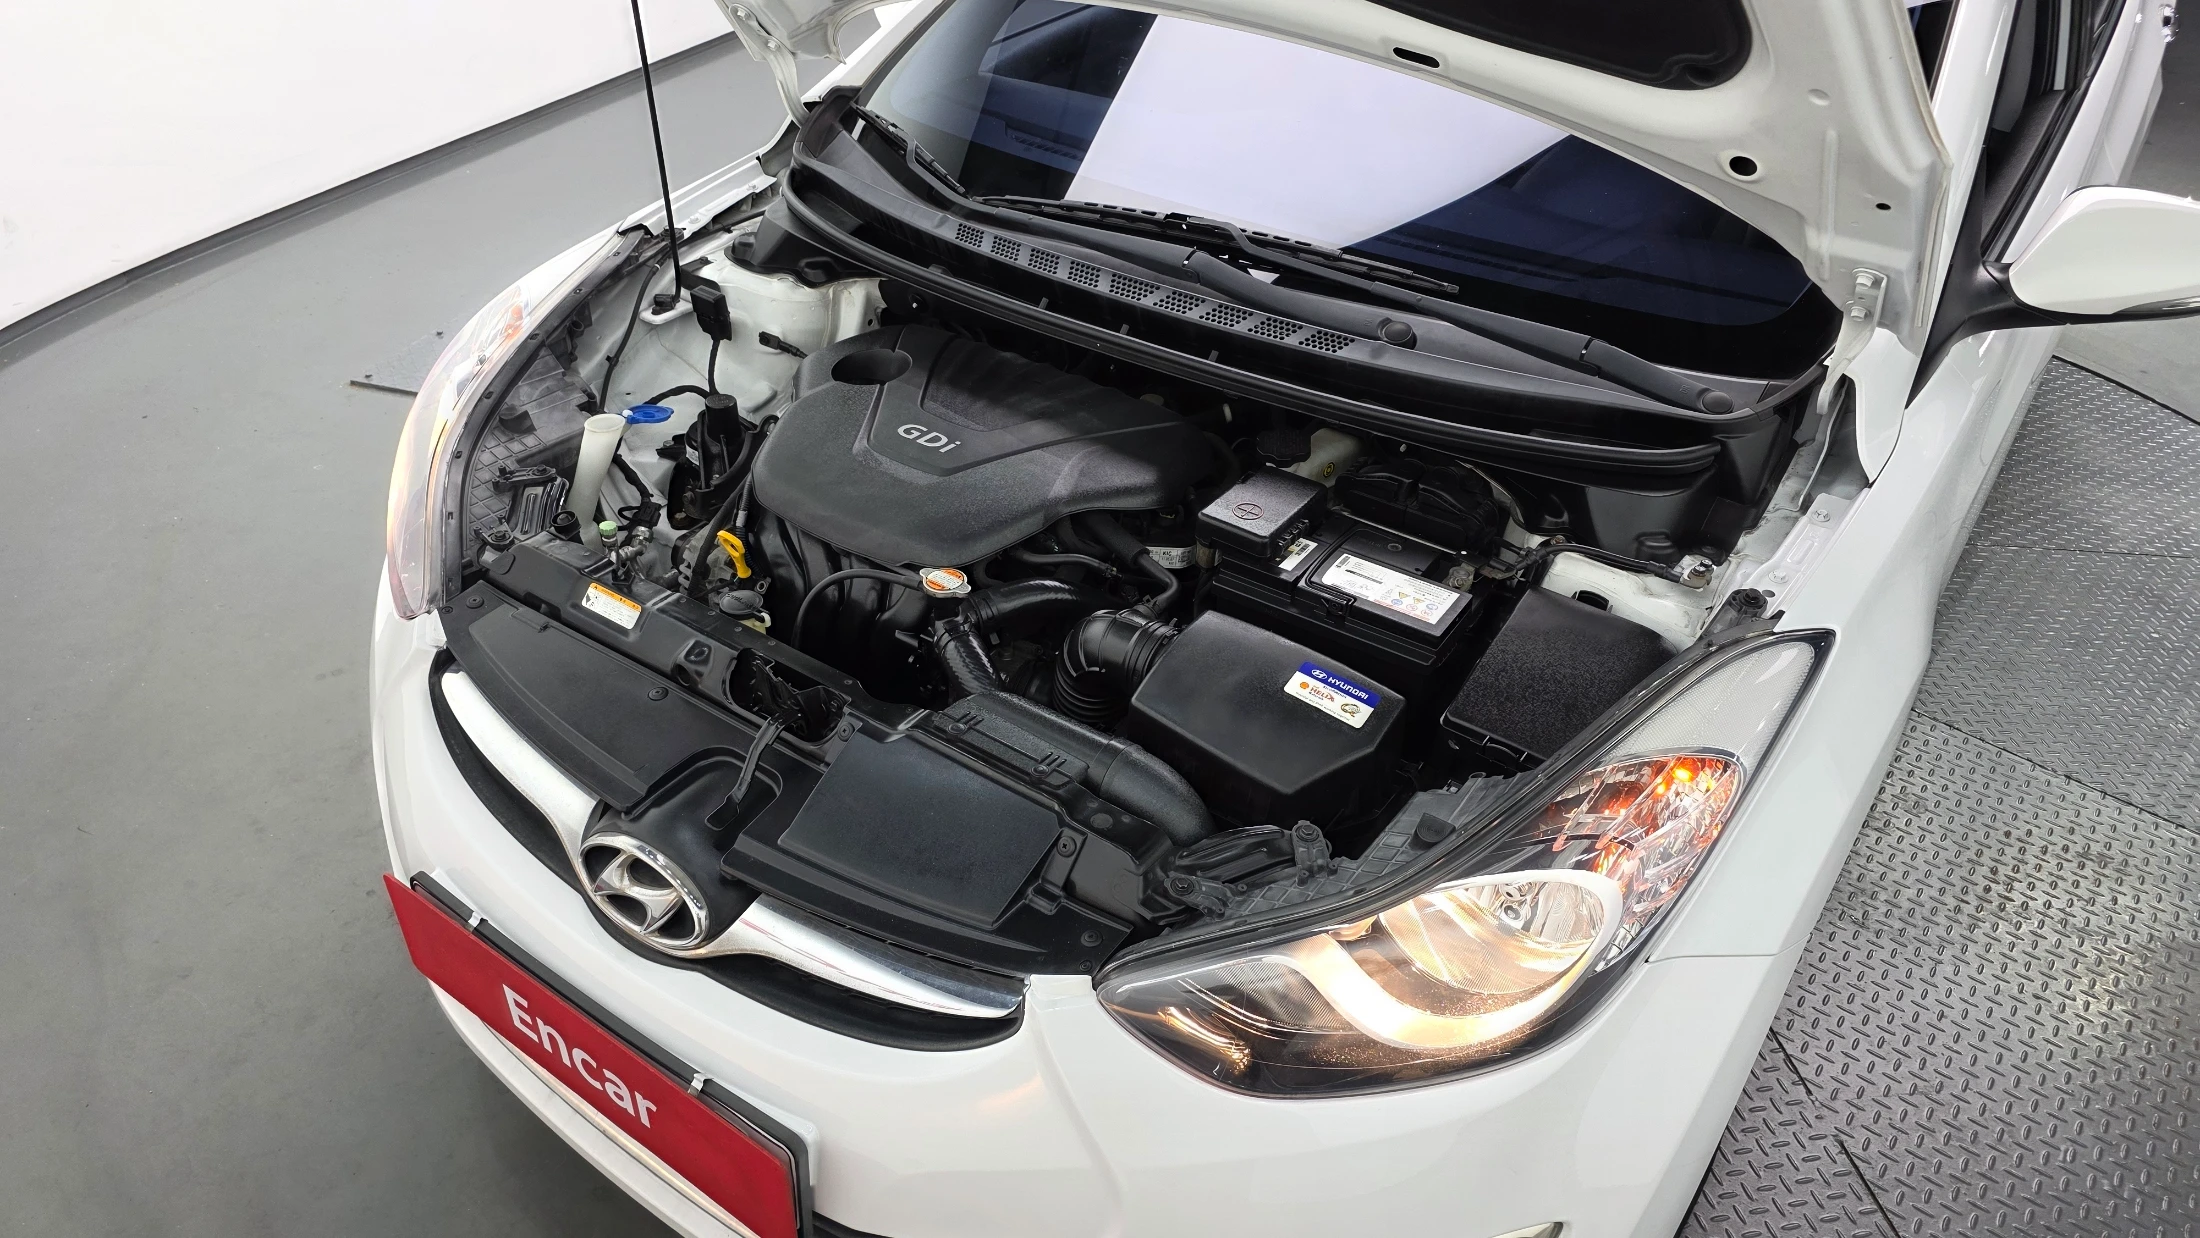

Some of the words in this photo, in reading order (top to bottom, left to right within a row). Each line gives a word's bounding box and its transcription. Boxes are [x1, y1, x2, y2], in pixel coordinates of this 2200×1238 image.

[897, 424, 961, 453] GDi
[1327, 676, 1369, 700] HYUNDAI
[502, 983, 658, 1129] Encar
